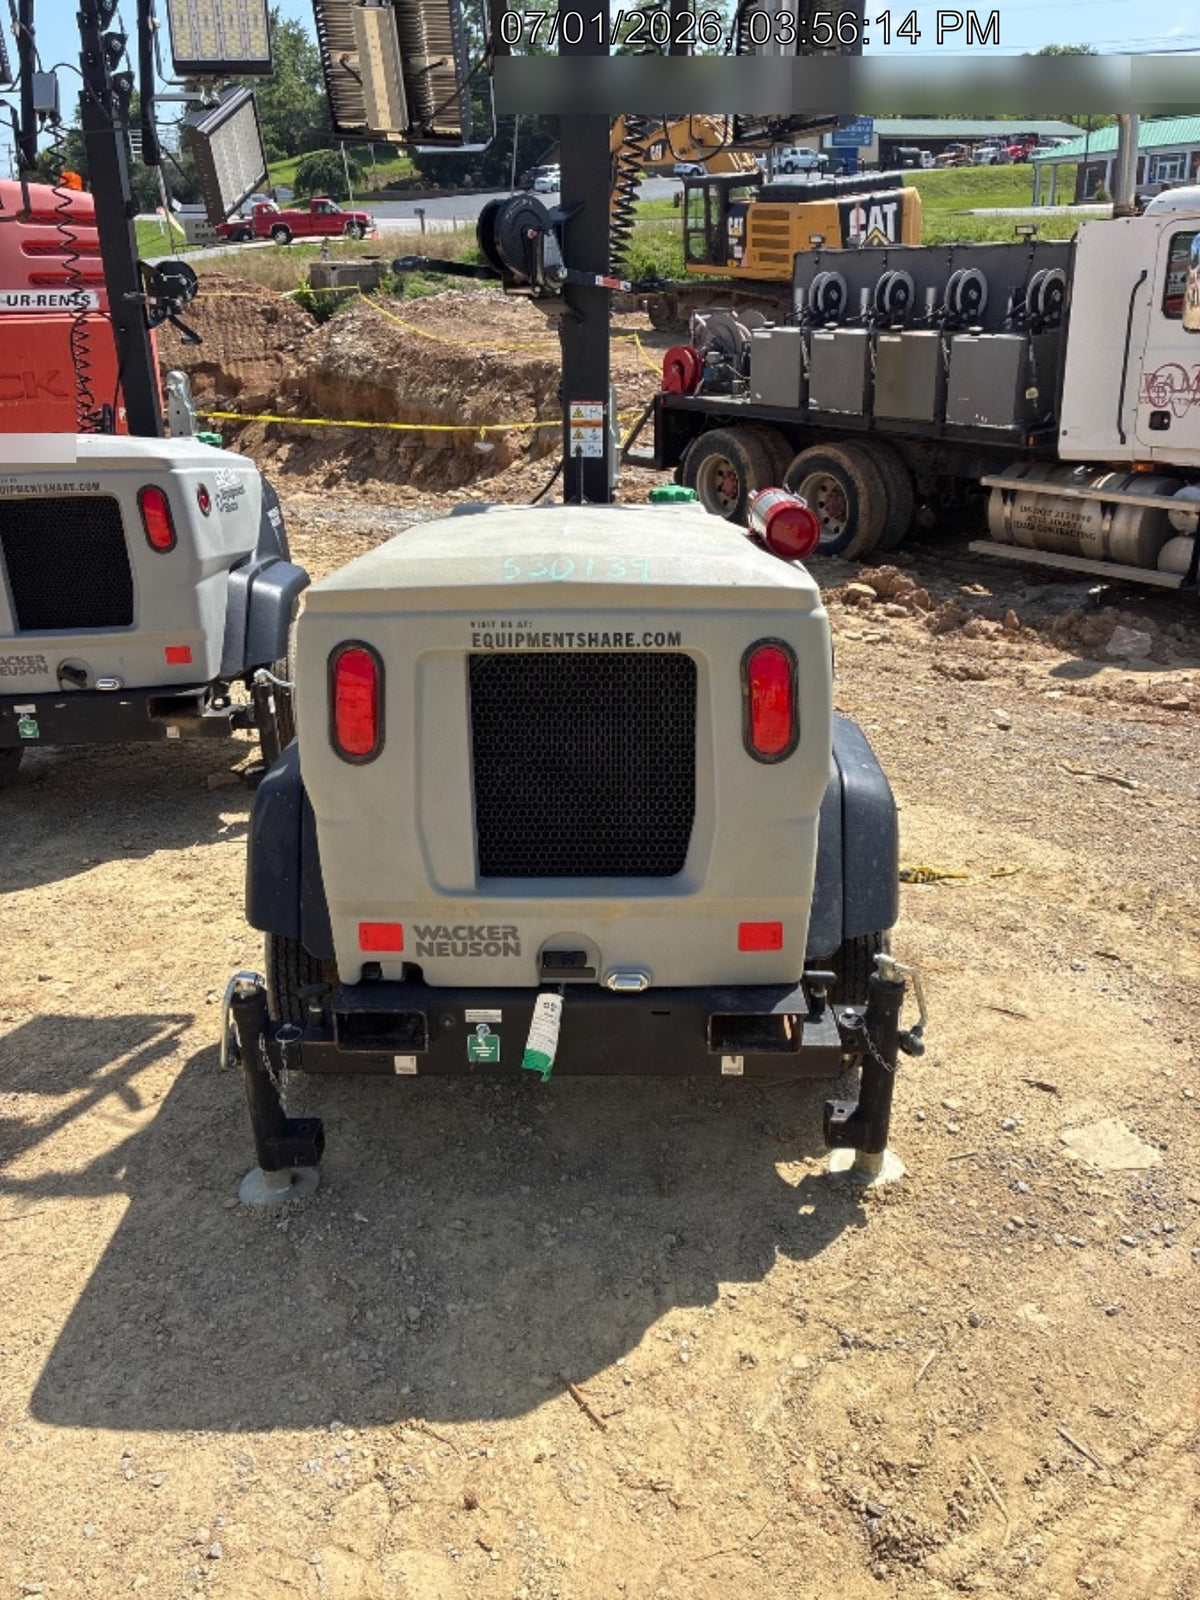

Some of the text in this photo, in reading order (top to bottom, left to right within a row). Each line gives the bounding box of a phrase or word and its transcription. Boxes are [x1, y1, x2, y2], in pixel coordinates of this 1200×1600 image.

[849, 202, 898, 248] CAT
[503, 556, 650, 583] 530139
[470, 620, 496, 629] VISIT
[500, 620, 513, 629] US
[471, 631, 682, 651] EQUIPMENTSHARE.COM
[412, 924, 521, 941] WACKER
[414, 941, 522, 958] NEUSON
